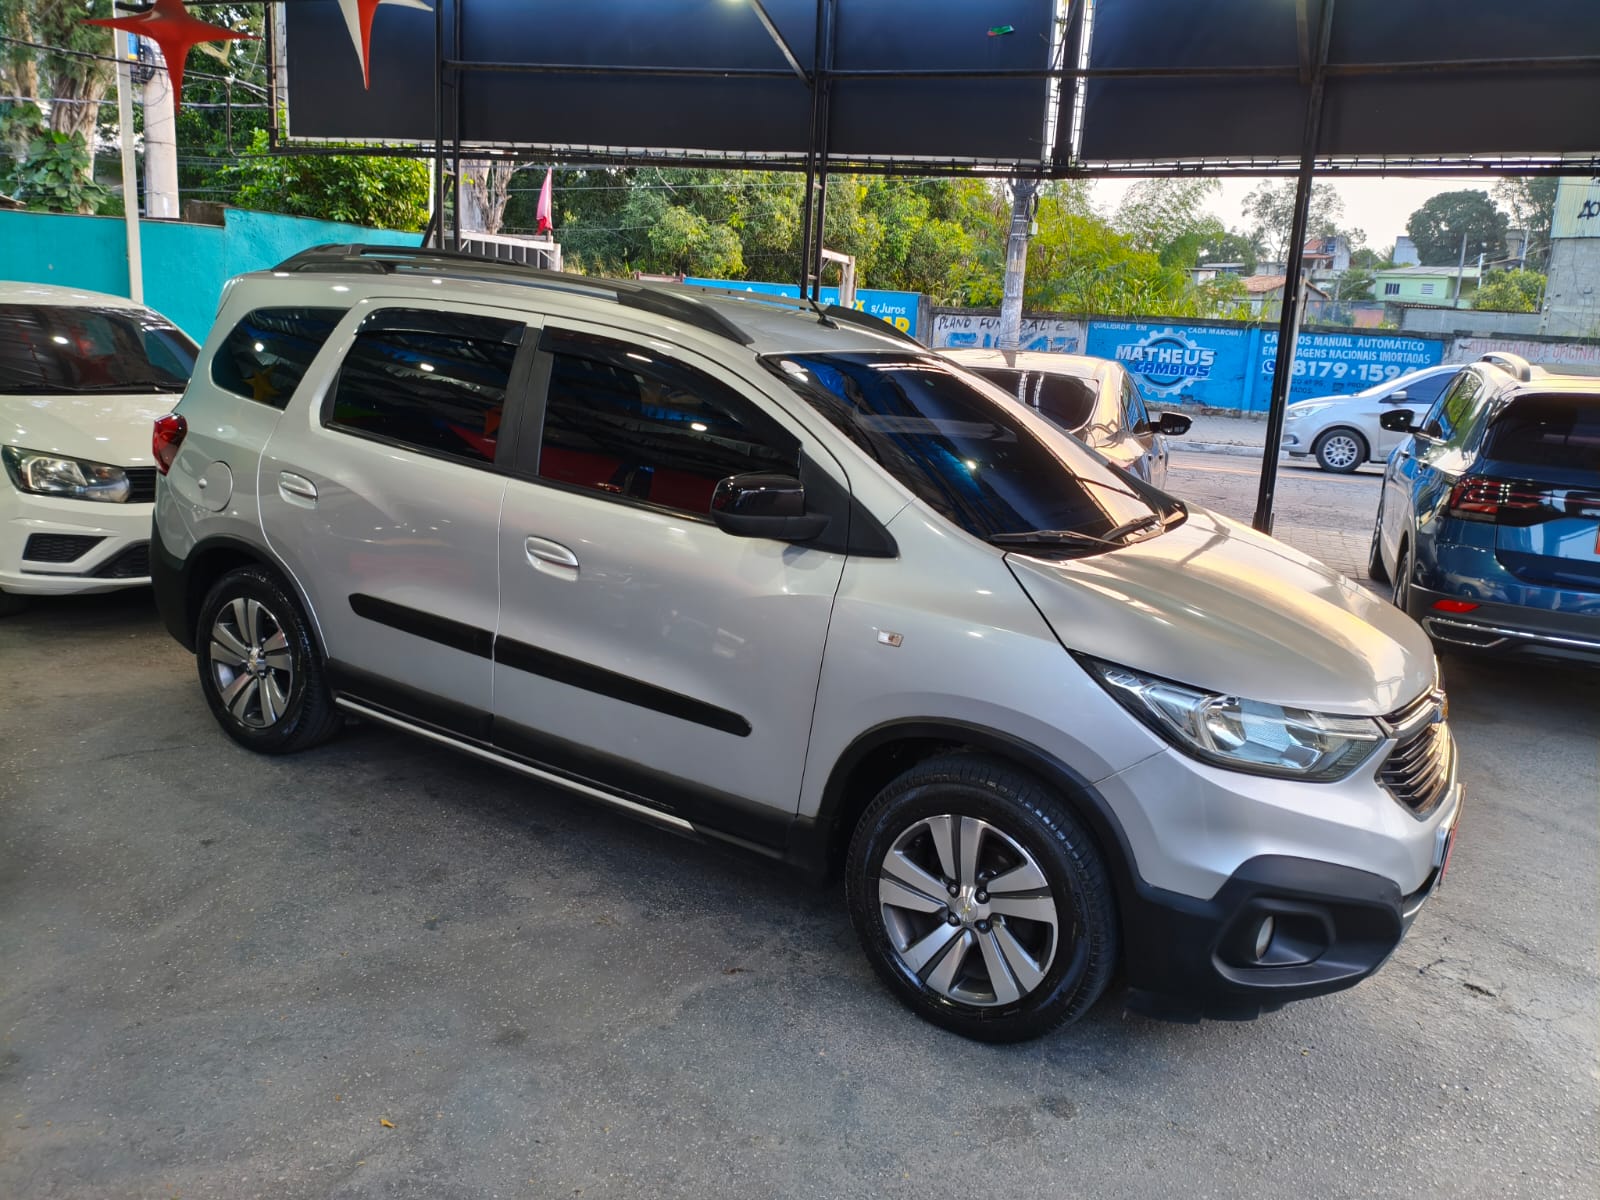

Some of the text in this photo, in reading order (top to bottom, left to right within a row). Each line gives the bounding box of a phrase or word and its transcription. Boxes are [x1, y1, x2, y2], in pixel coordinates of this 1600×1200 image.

[870, 303, 906, 315] s/Juros
[938, 316, 971, 330] PLANO
[1314, 336, 1352, 348] MANUAL
[1357, 337, 1425, 351] AUTOMÁTICO
[1115, 346, 1215, 366] MATHEUS
[1329, 349, 1377, 361] NACIONAIS
